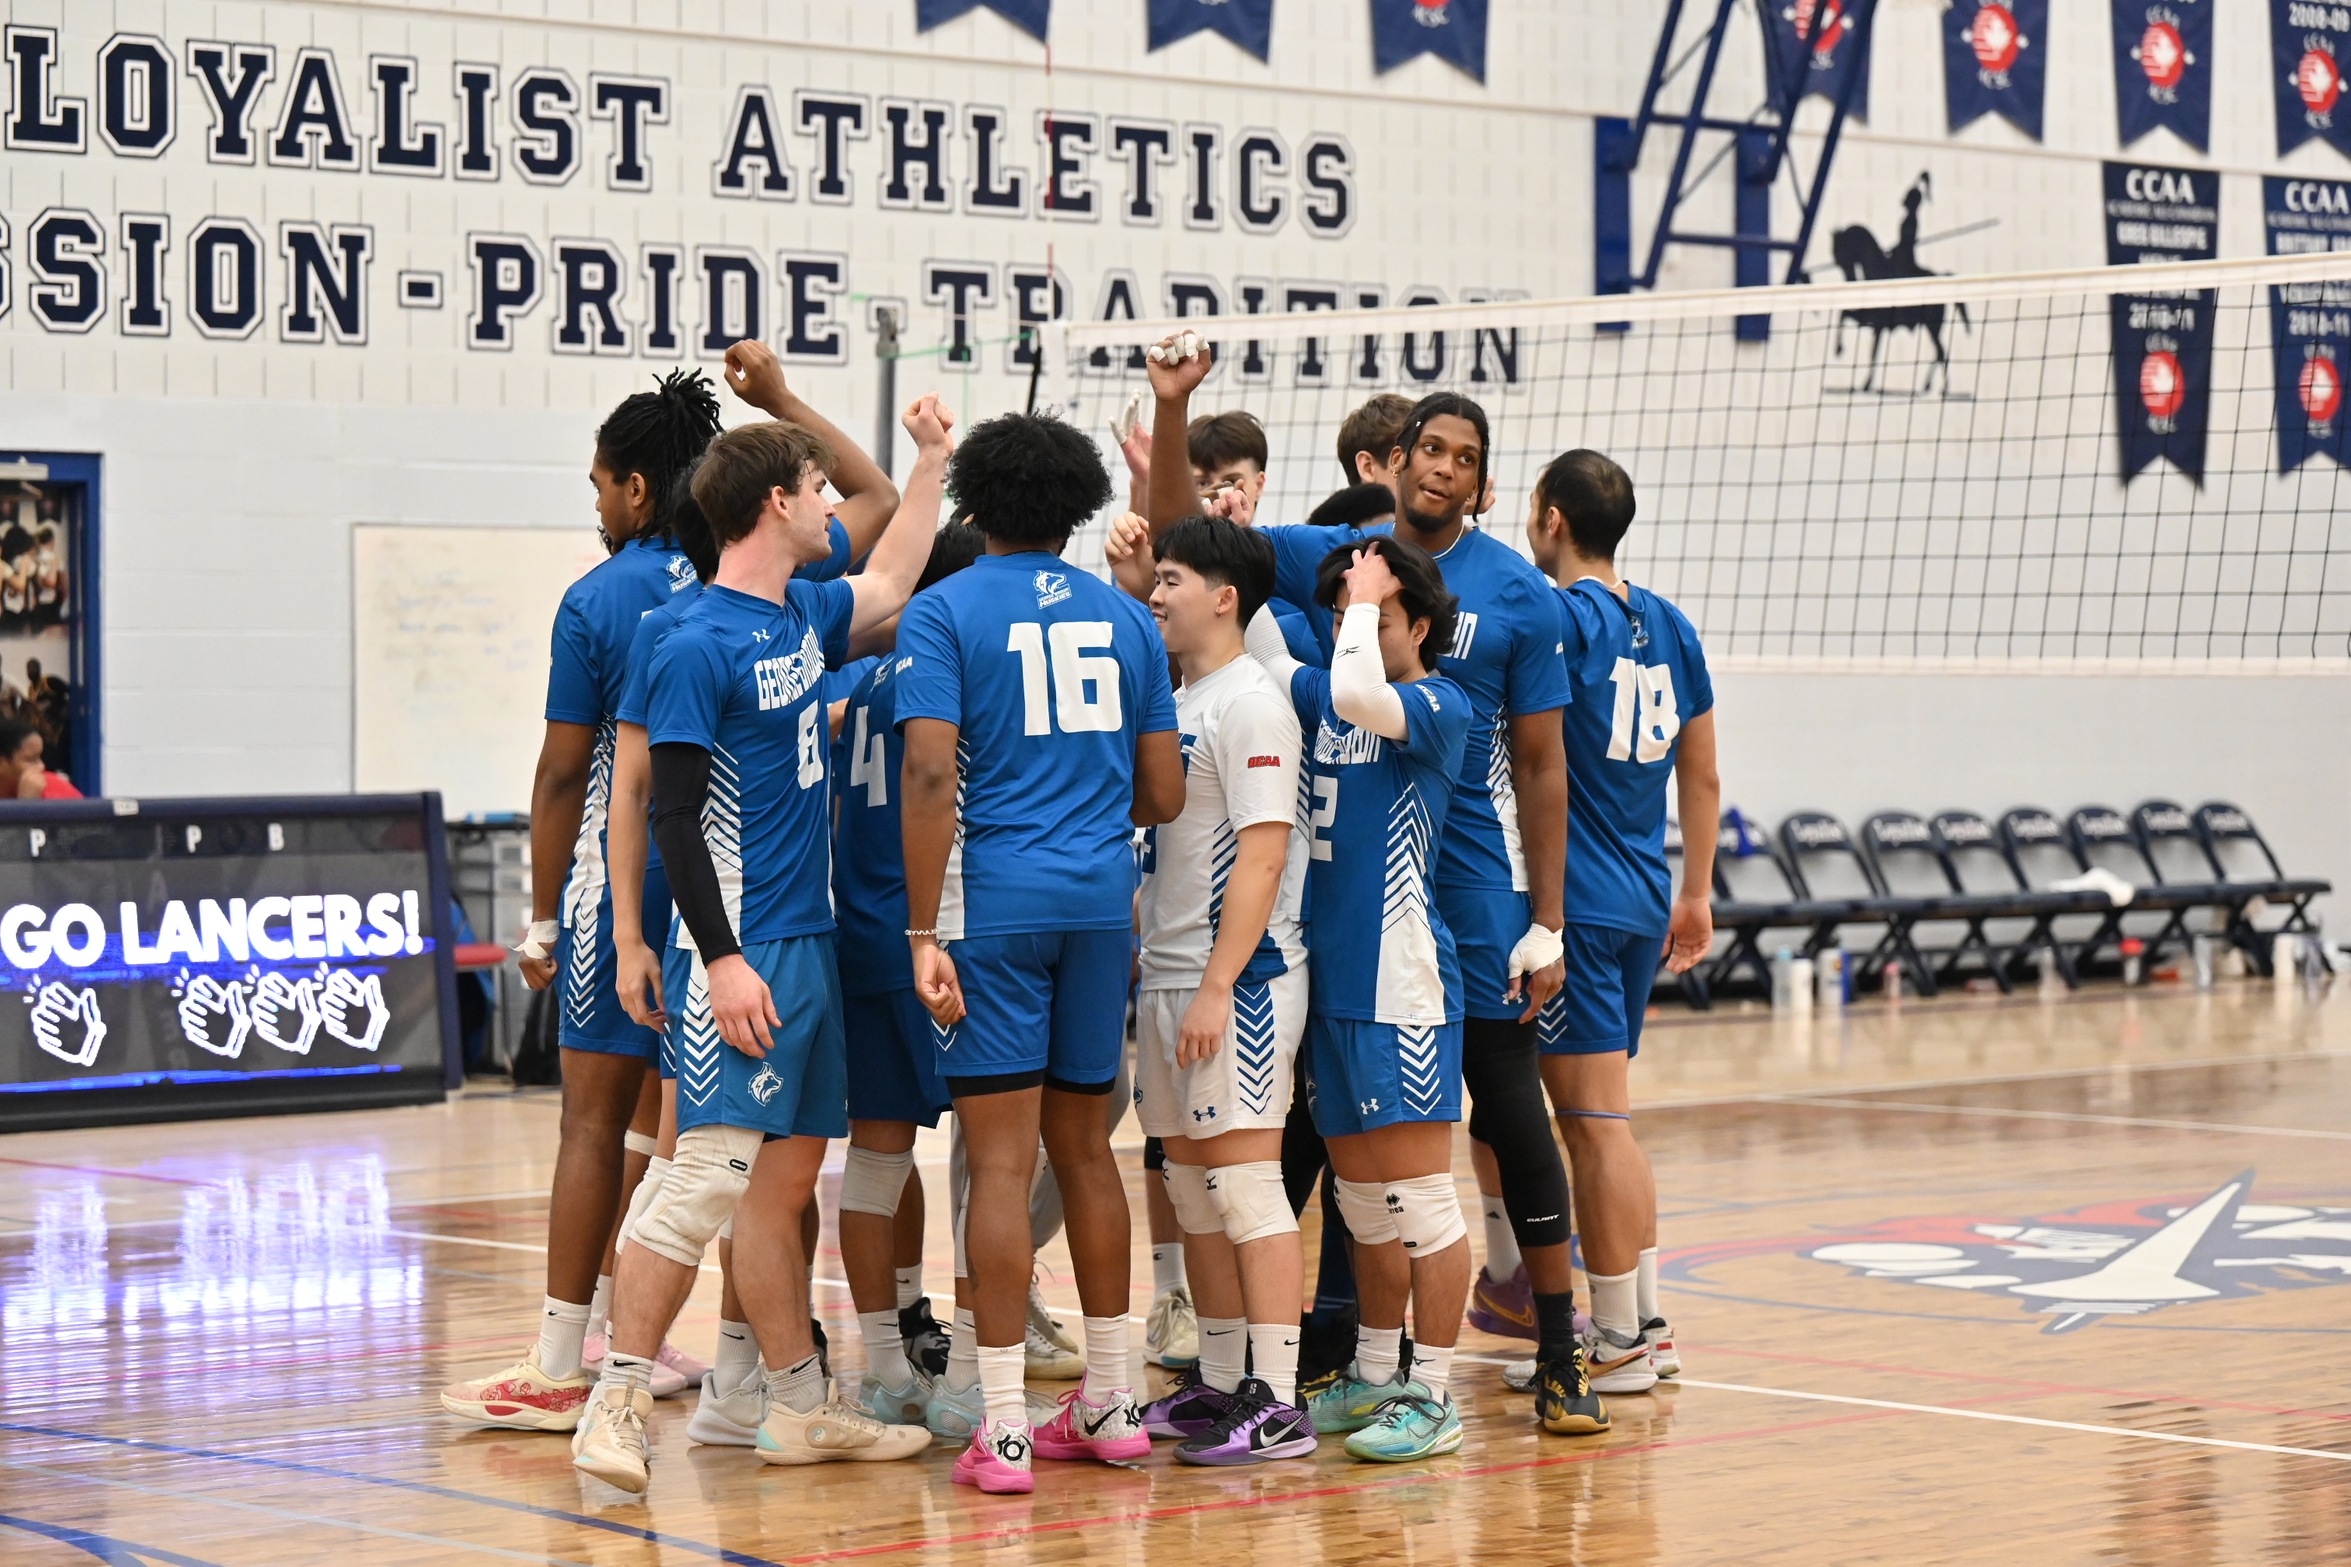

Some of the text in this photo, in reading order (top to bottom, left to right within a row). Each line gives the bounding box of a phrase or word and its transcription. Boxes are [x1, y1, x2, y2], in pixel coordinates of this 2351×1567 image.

[5, 24, 1357, 239] LOYALIST ATHLETICS
[2126, 169, 2195, 205] CCAA
[2285, 181, 2350, 214] CCAA
[0, 207, 373, 345] SION
[468, 231, 847, 366] PRIDE
[921, 258, 1531, 396] TRADITION
[1007, 620, 1123, 737] 16
[1606, 656, 1680, 764] 18
[797, 699, 824, 790] 6
[850, 705, 887, 808] 4
[30, 823, 284, 857] P P B
[1309, 774, 1338, 862] 2
[0, 889, 424, 969] GO LANCERS!
